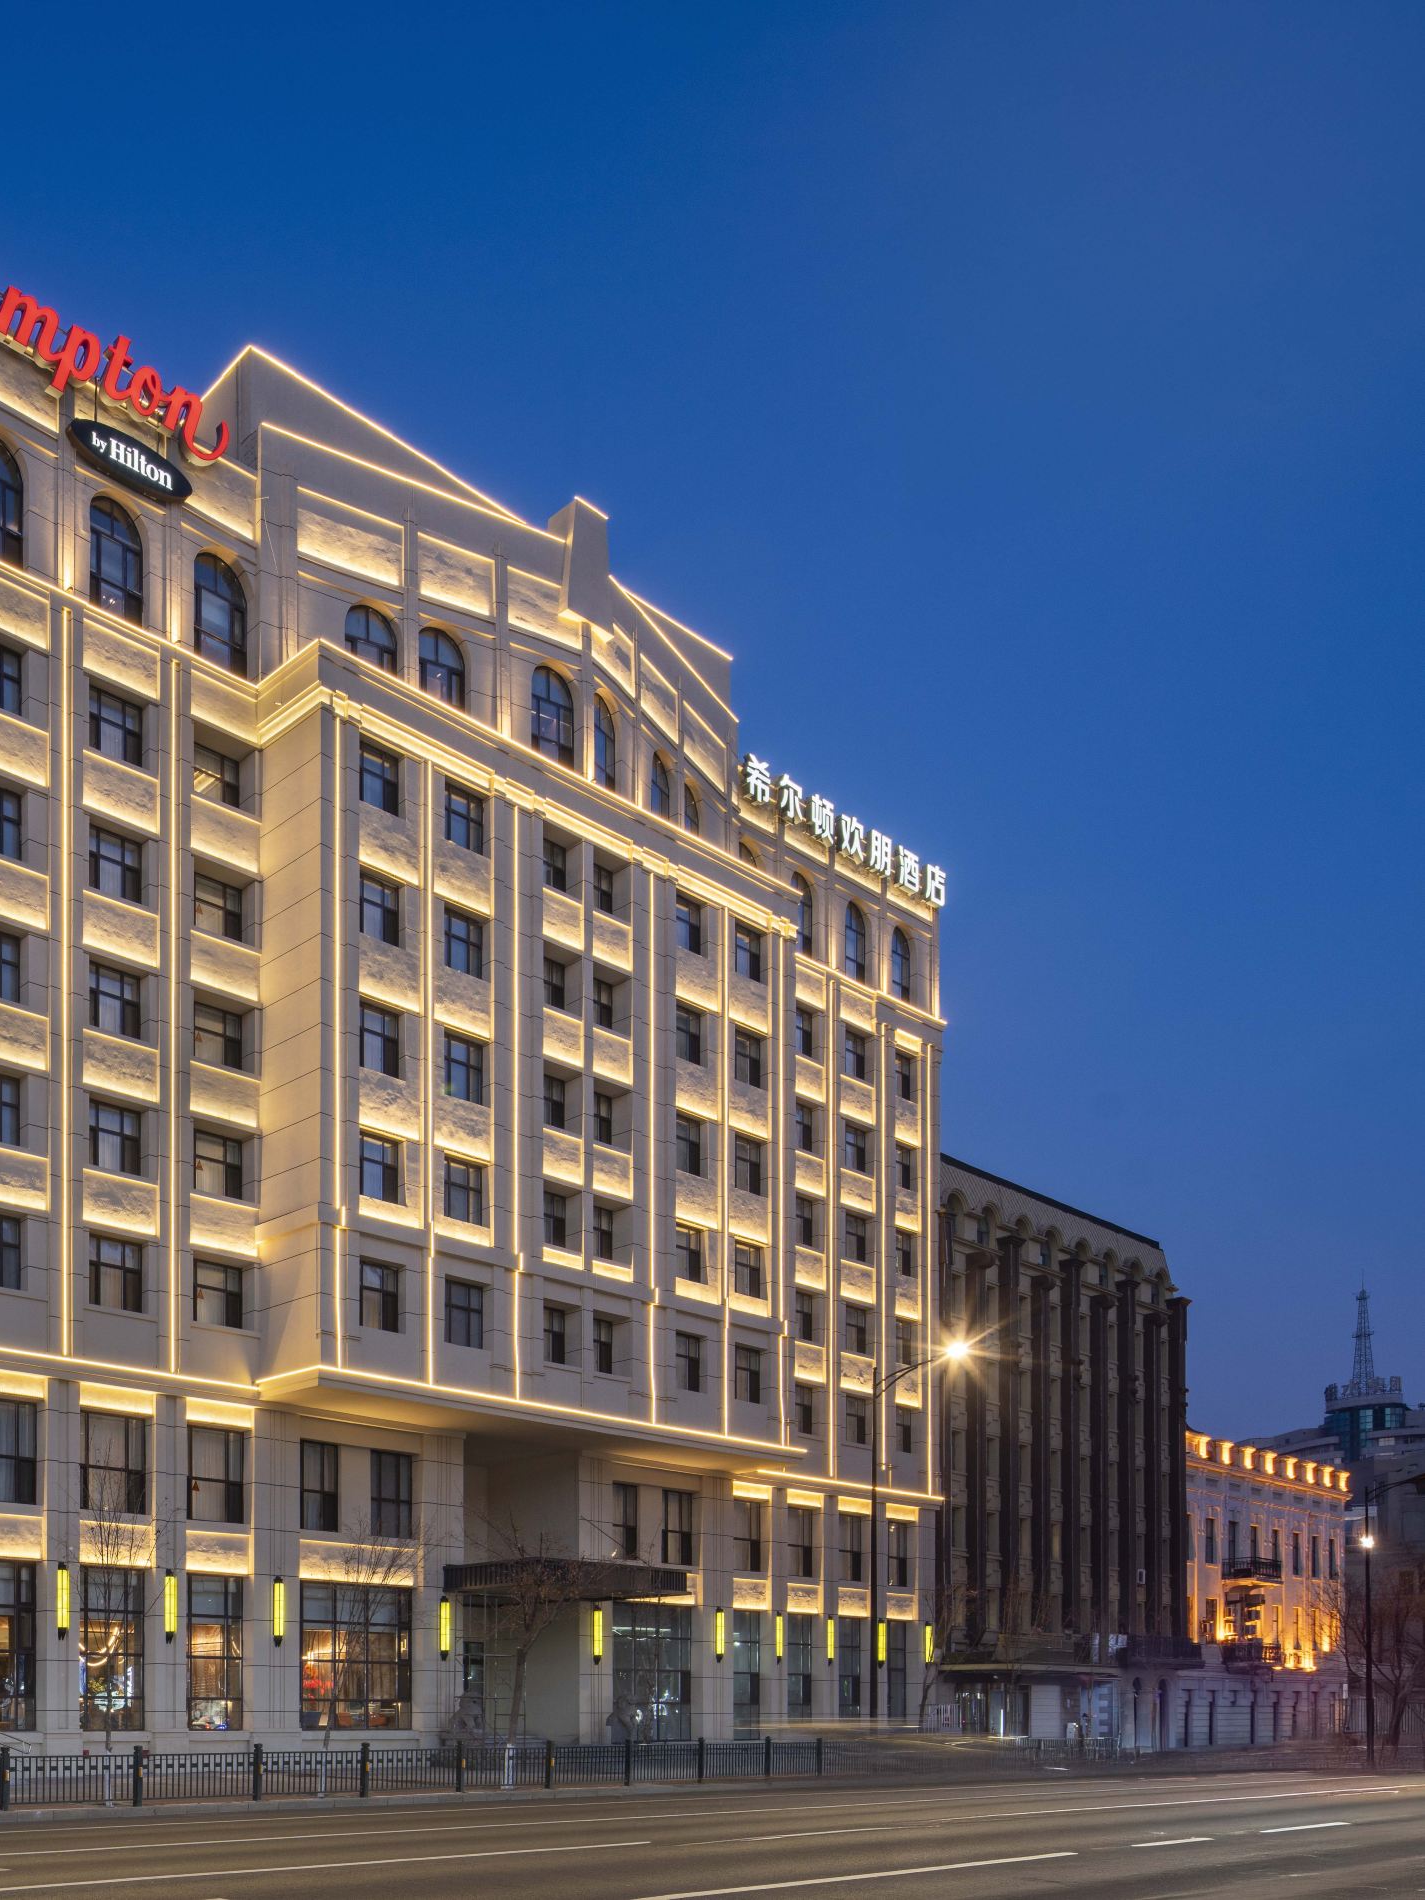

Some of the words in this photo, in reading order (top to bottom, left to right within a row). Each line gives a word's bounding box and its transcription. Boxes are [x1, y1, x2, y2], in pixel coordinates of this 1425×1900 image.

[91, 430, 107, 453] by
[109, 437, 173, 491] Hilton
[744, 753, 947, 908] 希尔顿欢朋酒店
